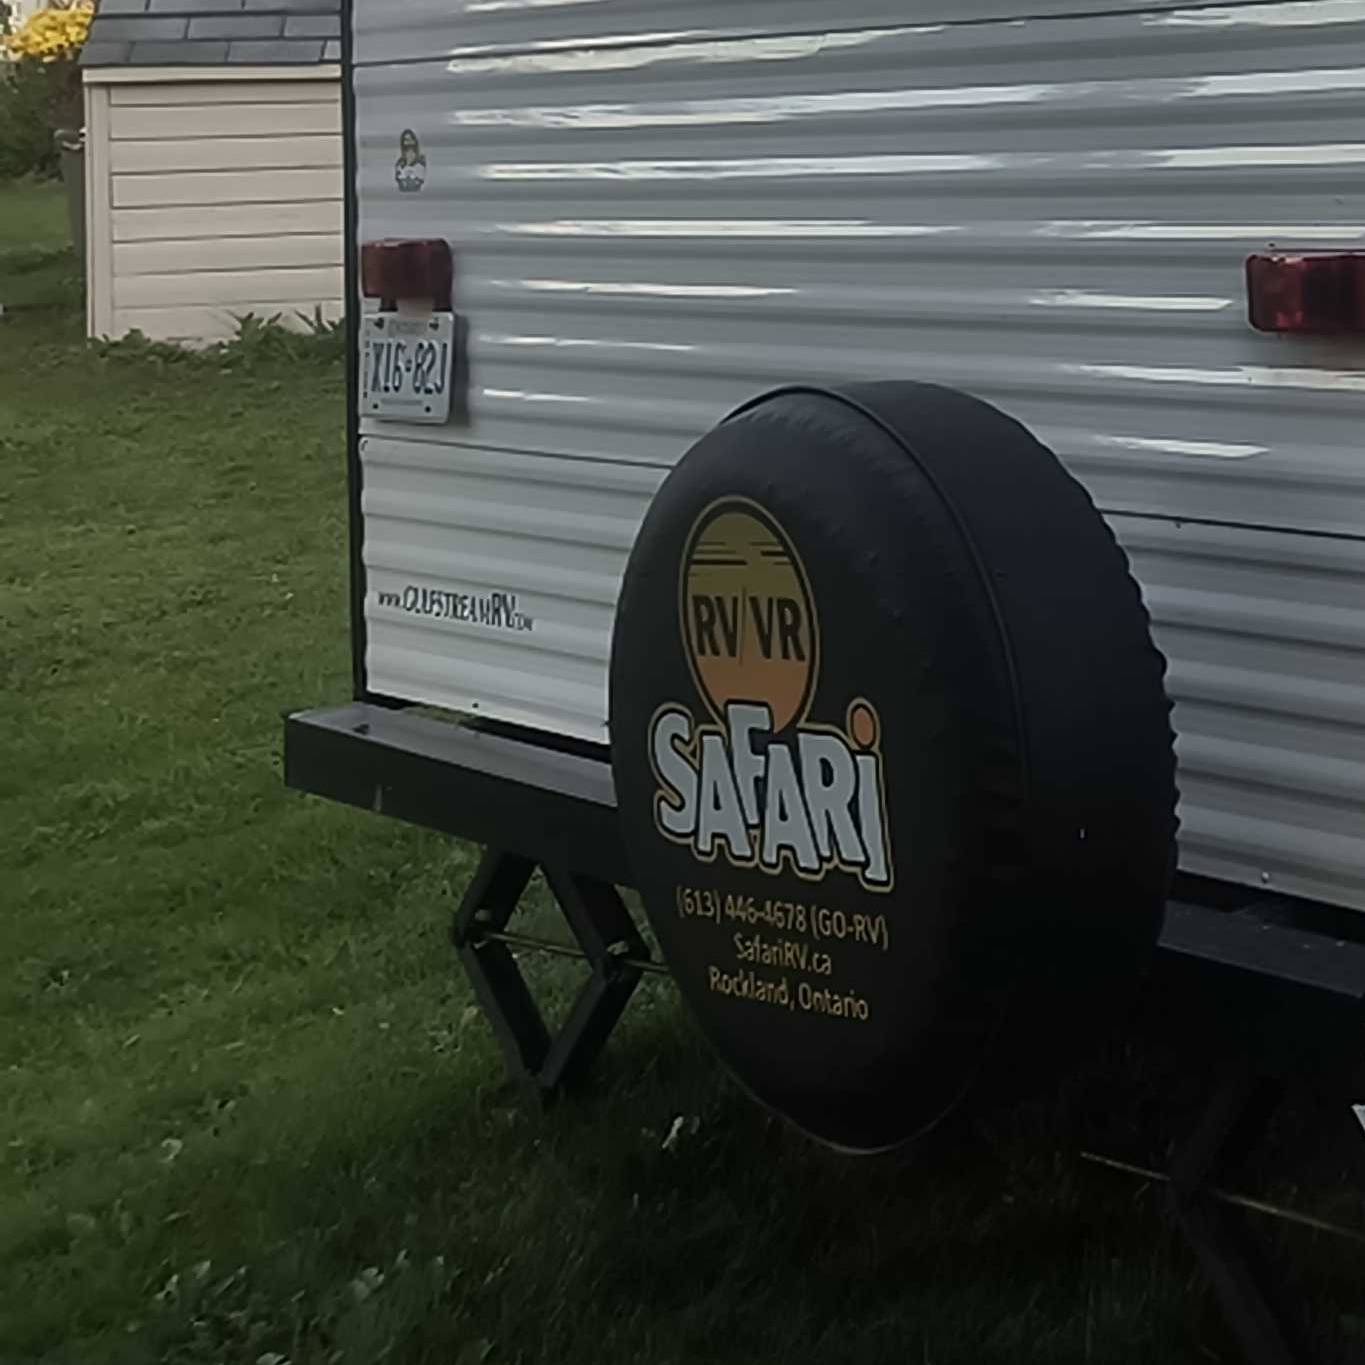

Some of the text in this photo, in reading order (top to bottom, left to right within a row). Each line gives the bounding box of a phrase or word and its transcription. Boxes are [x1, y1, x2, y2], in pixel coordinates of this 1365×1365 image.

[676, 886, 889, 951] (613) 446-4678 (GO-RV)
[733, 932, 833, 975] SafariRV.ca
[708, 965, 869, 1021] Rockland, Ontario
